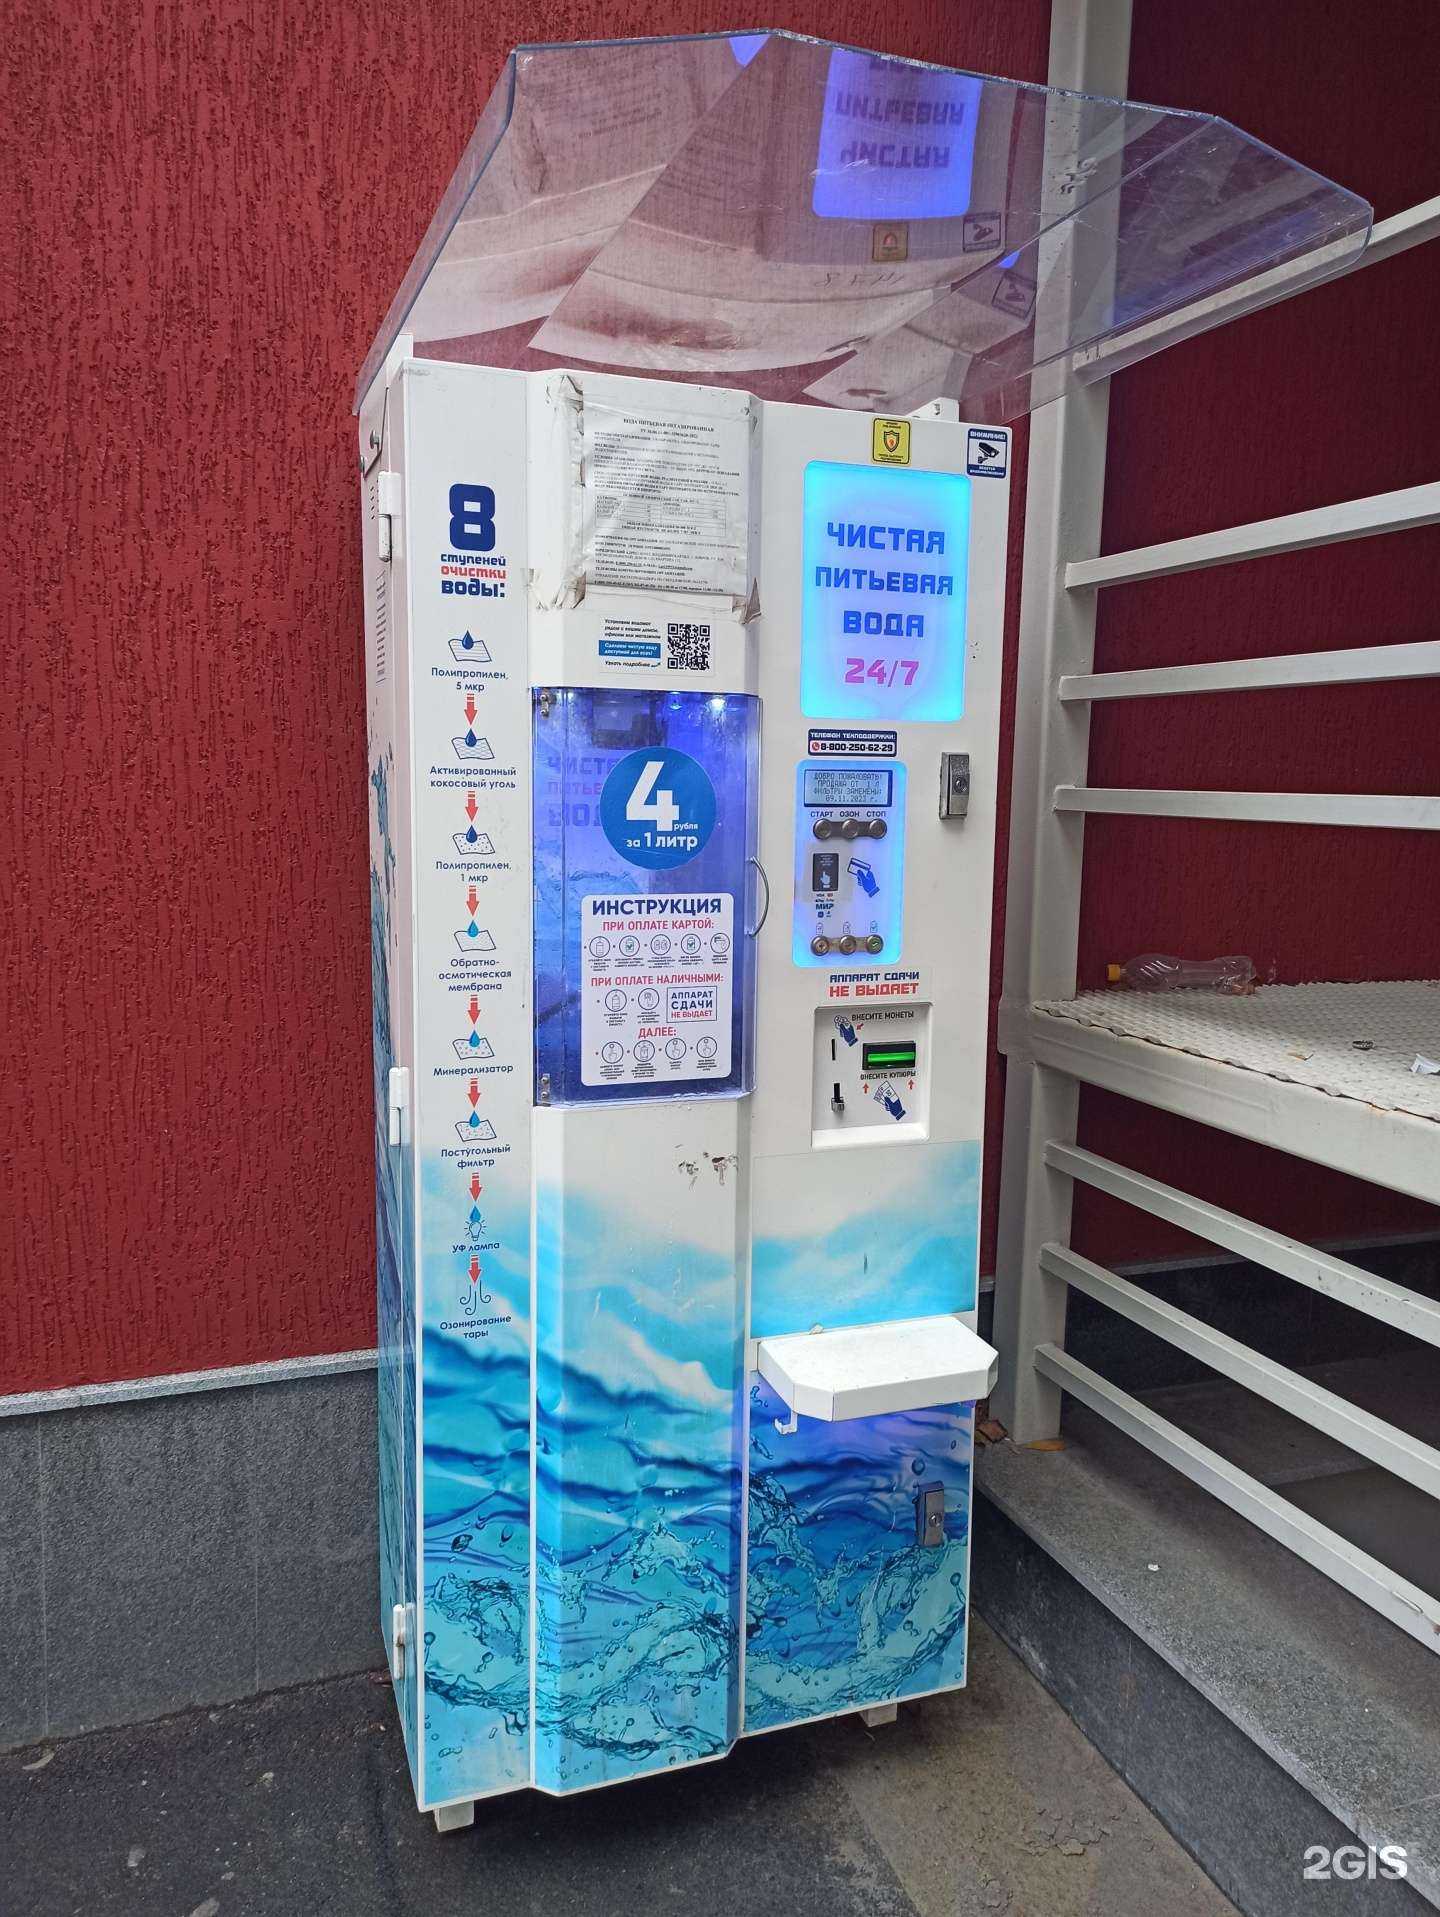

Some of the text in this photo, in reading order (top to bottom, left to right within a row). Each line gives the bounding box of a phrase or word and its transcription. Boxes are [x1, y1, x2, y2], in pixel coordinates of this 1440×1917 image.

[449, 483, 495, 552] 8
[827, 522, 945, 554] ЧИСТАЯ
[440, 553, 506, 566] ступеней
[440, 566, 506, 579] очистки
[815, 566, 953, 596] ПИТЬЕВАЯ
[441, 578, 505, 598] воды:
[843, 610, 924, 638] ВОДА
[844, 657, 920, 688] 24/7
[456, 682, 485, 692] 5 мкр
[429, 766, 517, 779] Активированный
[430, 779, 516, 790] кокосовый уголь
[626, 761, 698, 832] 4 рубля
[626, 832, 698, 852] за 1 литр
[460, 873, 489, 884] 1 мкр
[592, 898, 722, 916] ИНСТРУКЦИЯ
[602, 918, 715, 931] ПРИ ОПЛАТЕ КАРТОЙ:
[450, 958, 501, 969] Обратно-
[438, 970, 512, 980] осмотическая
[591, 972, 724, 987] ПРИ ОПЛАТЕ НАЛИЧНЫМИ:
[829, 971, 920, 983] АППАРАТ СДАЧИ
[448, 982, 502, 993] мембрана
[829, 983, 919, 997] НЕ ВЫДАЕТ
[671, 990, 713, 1000] АППАРАТ
[671, 1000, 713, 1010] СДАЧИ
[671, 1010, 713, 1019] НЕ ВЫДАЕТ
[851, 1010, 915, 1022] ВНЕСИТЕ МОНЕТЫ
[638, 1026, 677, 1039] ДАЛЕЕ:
[433, 1065, 514, 1077] Минерализатор
[860, 1070, 917, 1081] ВНЕСИТЕ КУПЮРЫ
[440, 1143, 511, 1158] Постугольный
[457, 1159, 495, 1170] фильтр
[468, 1241, 500, 1252] лампа
[439, 1314, 512, 1331] Озонирование
[463, 1330, 489, 1340] тары
